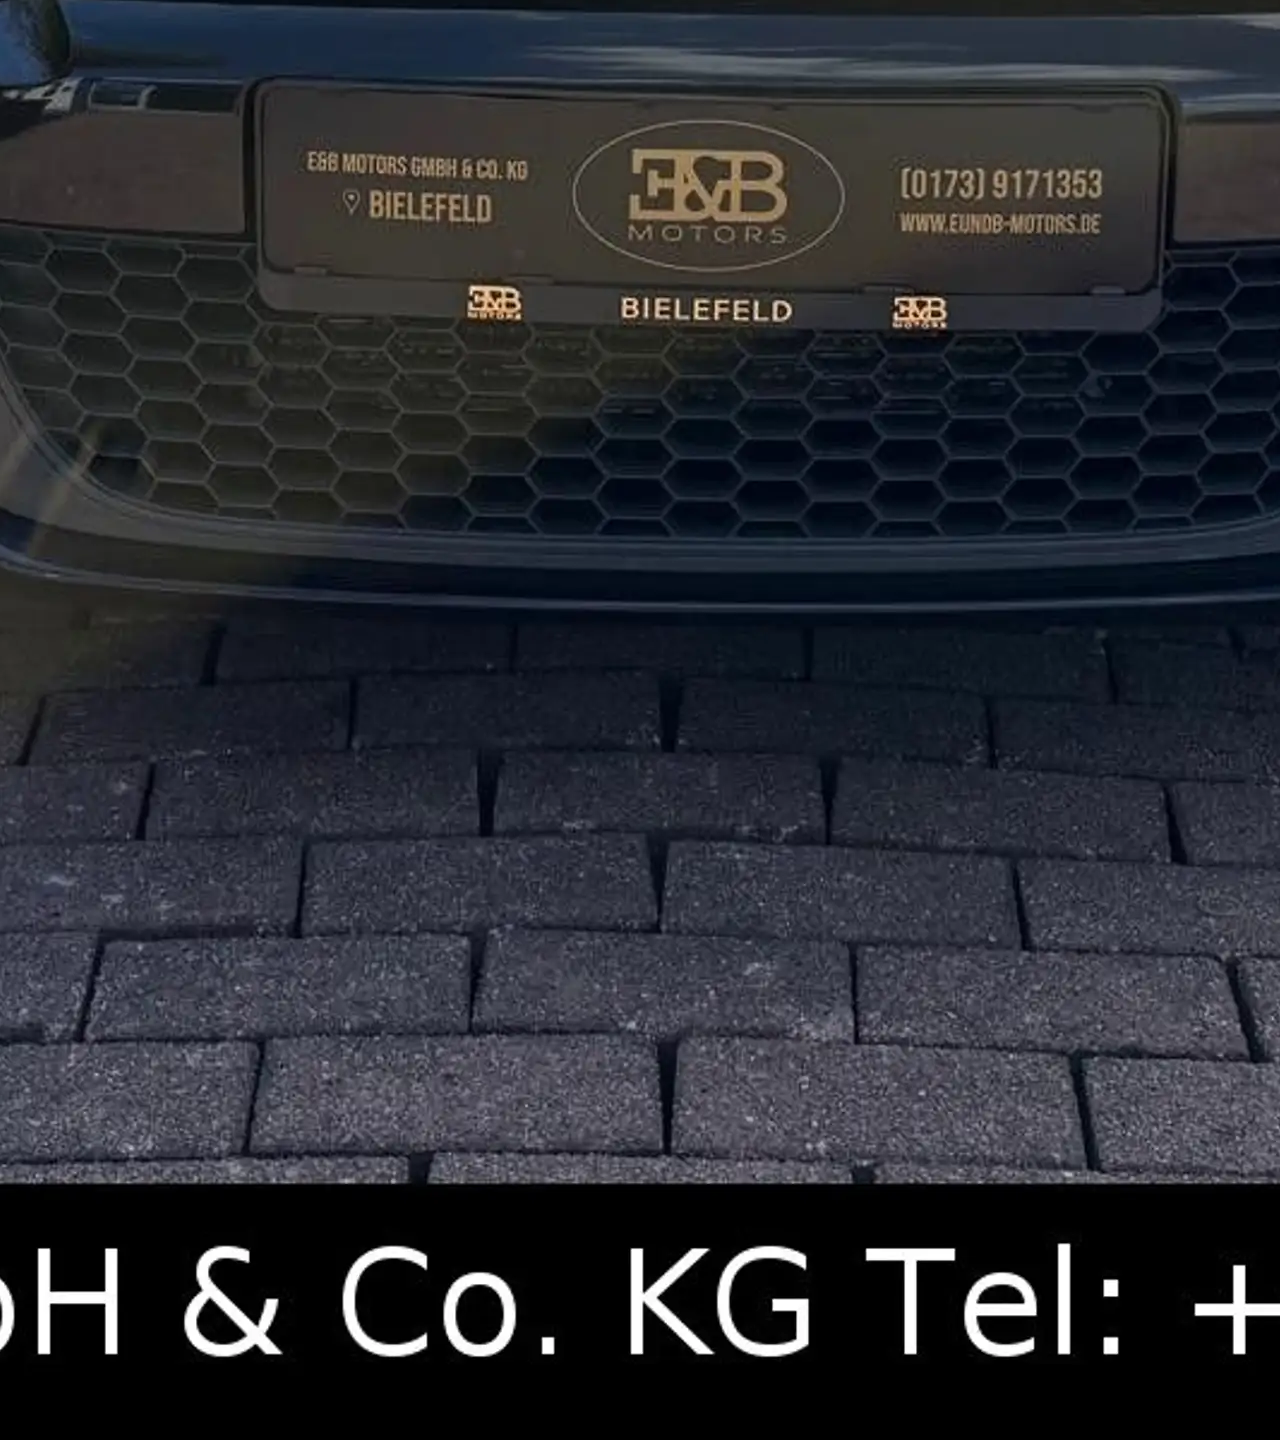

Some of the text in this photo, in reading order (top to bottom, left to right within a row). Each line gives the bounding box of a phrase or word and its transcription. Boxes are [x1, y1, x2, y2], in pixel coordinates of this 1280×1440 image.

[307, 150, 339, 172] E&B
[341, 153, 408, 177] MOTORS
[410, 156, 457, 179] GMBH
[476, 159, 504, 180] CO.
[507, 160, 529, 181] KG
[628, 147, 788, 222] E&B
[900, 167, 1103, 200] (0173) 9171353
[369, 189, 493, 223] BIELEFELD
[627, 224, 788, 245] MOTORS
[899, 211, 1102, 235] WWW.EUNDB-MOTORS.DE
[620, 296, 793, 323] BIELEFELD
